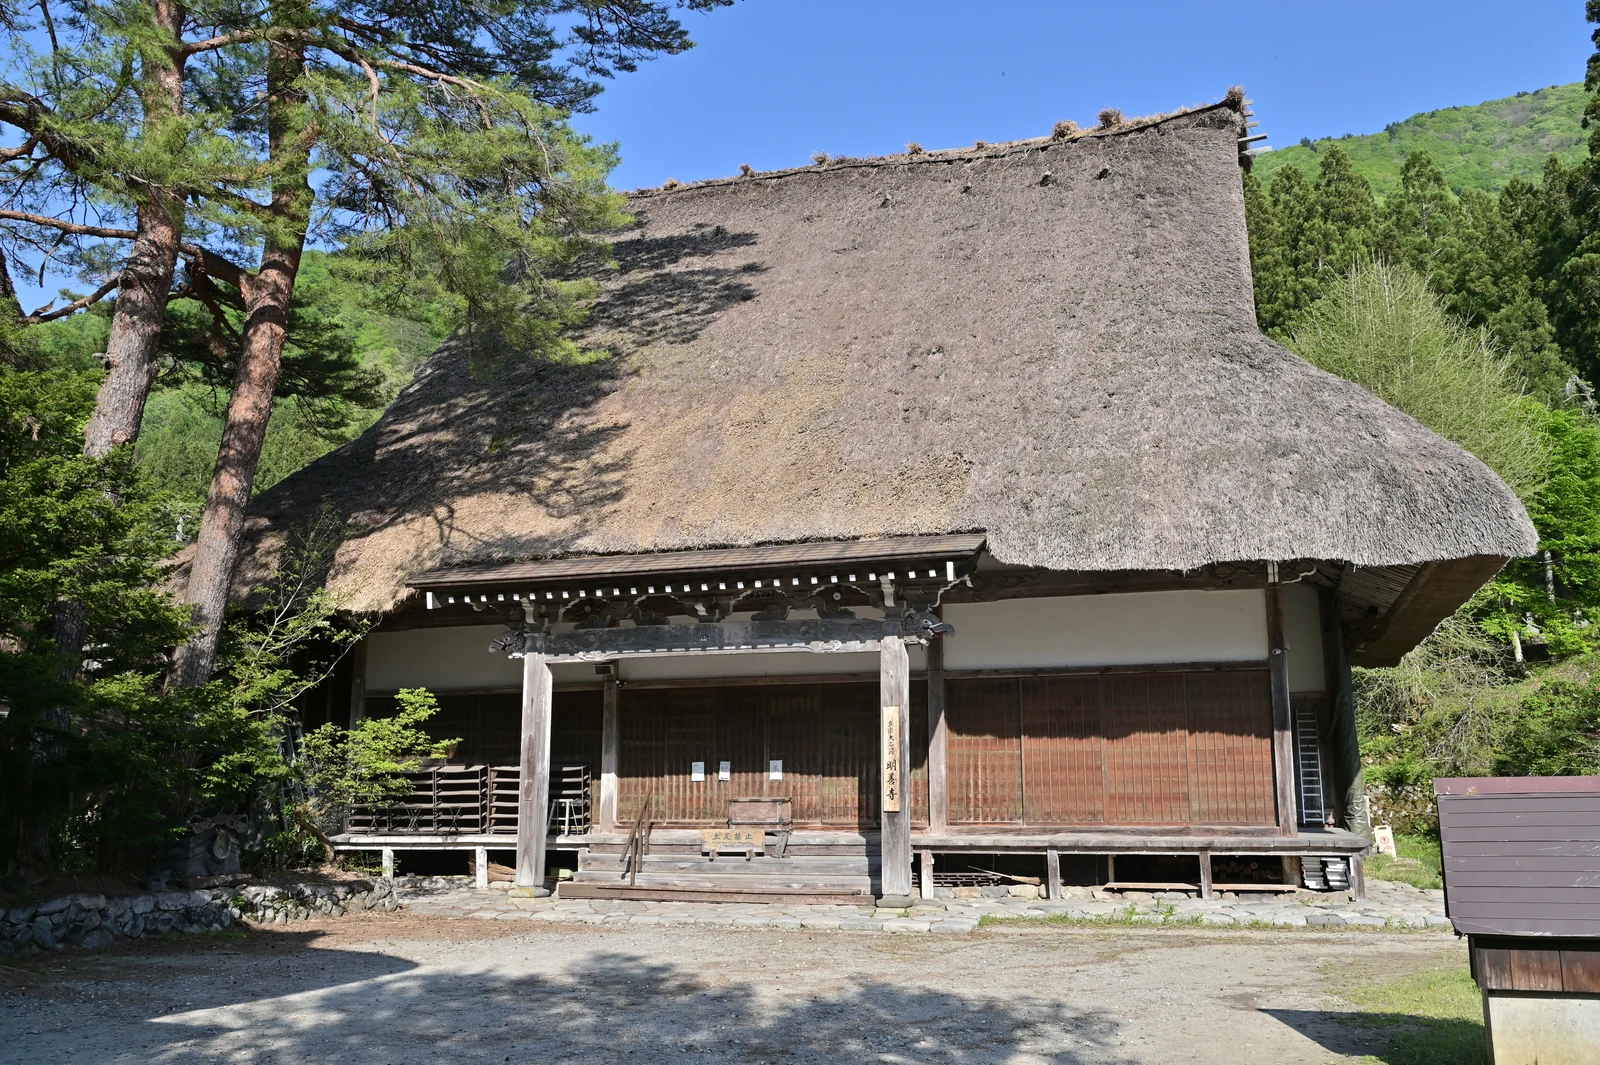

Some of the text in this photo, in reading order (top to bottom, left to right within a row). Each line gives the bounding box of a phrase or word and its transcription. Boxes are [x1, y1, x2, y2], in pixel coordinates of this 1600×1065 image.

[886, 759, 898, 801] 明善寺
[712, 832, 753, 840] 土足禁止
